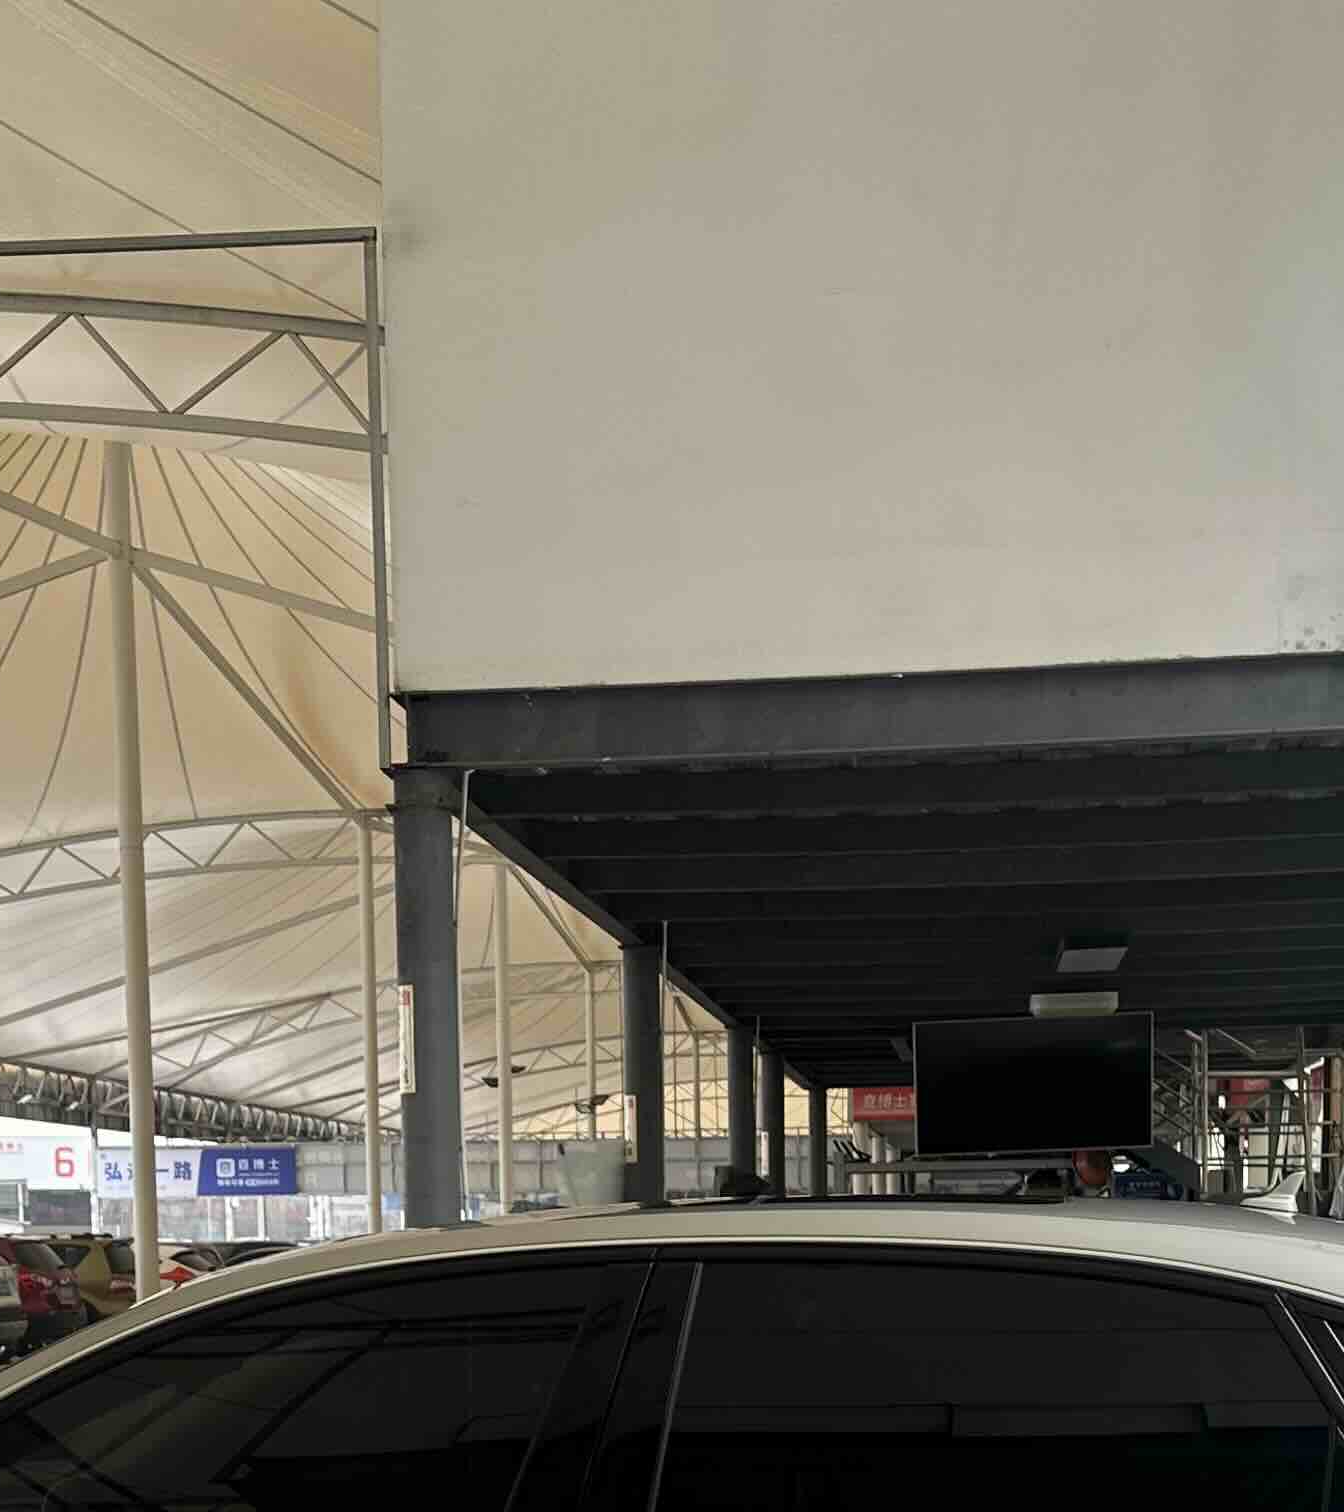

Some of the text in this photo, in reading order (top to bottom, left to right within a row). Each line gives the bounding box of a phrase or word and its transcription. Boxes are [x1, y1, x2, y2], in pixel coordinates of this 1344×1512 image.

[55, 1146, 74, 1178] 6
[104, 1161, 193, 1182] 弘一路
